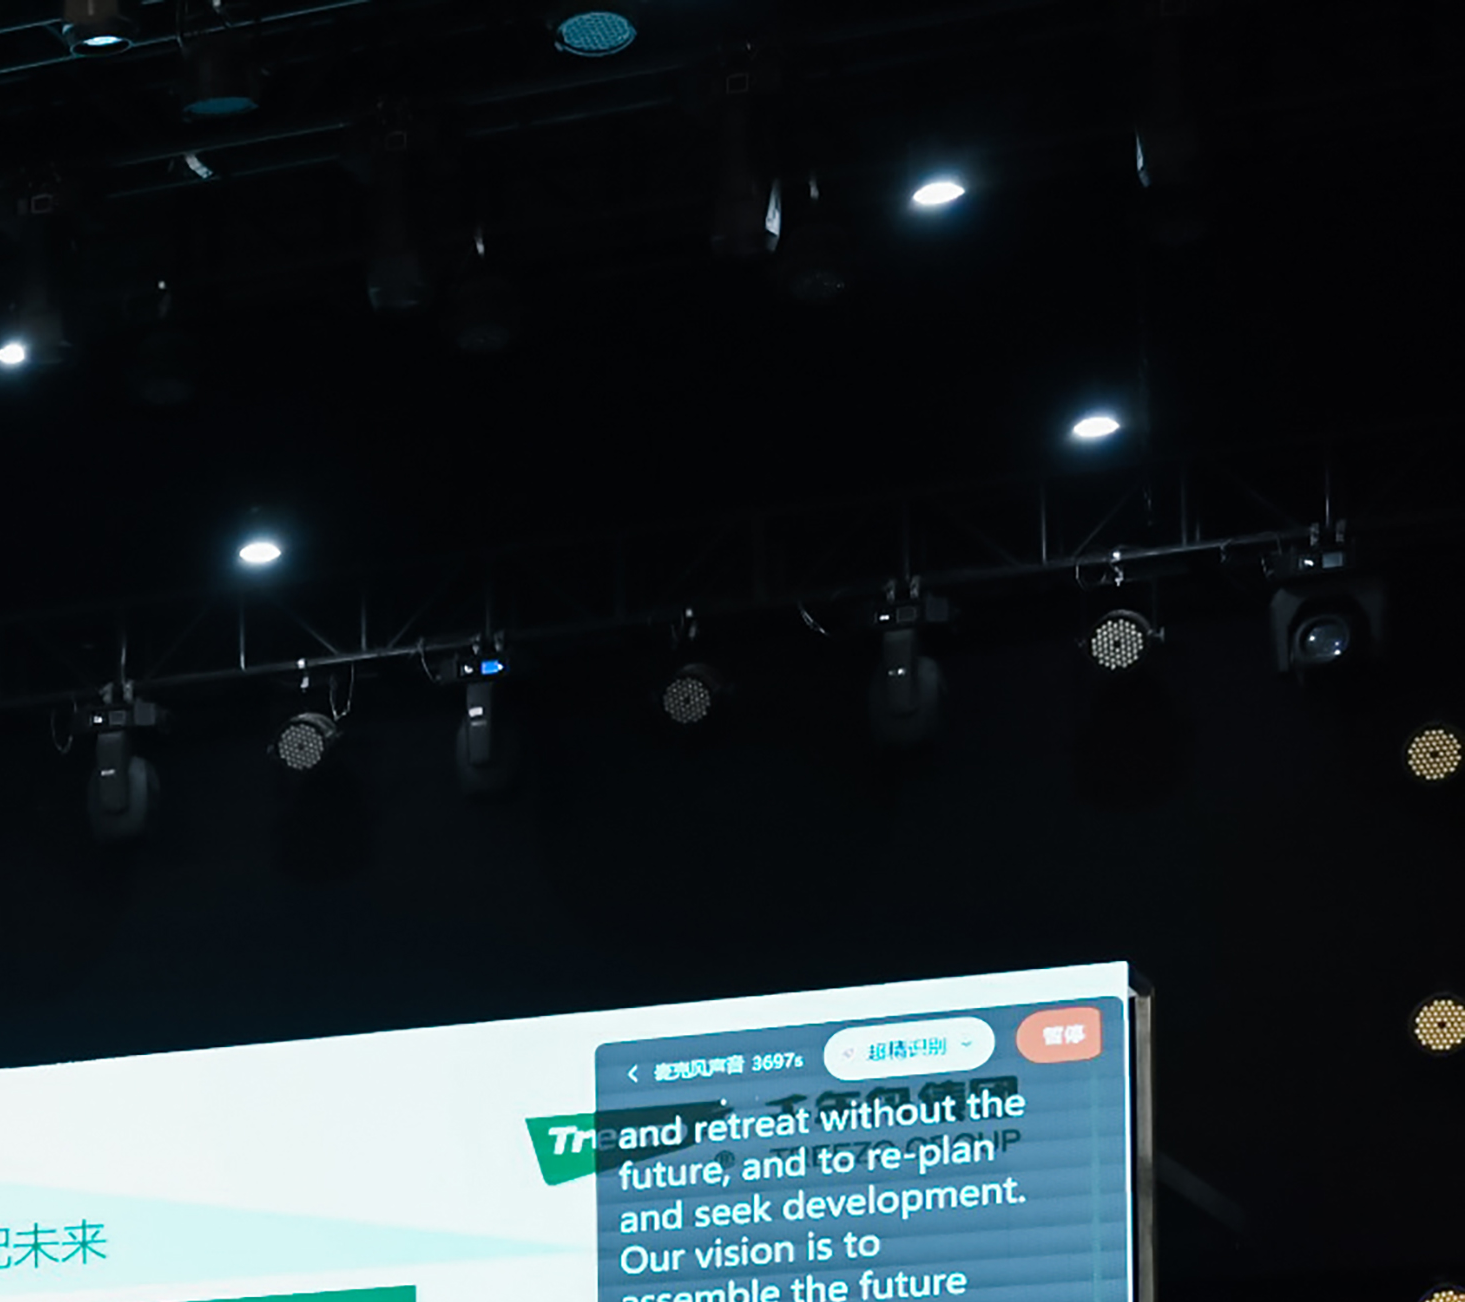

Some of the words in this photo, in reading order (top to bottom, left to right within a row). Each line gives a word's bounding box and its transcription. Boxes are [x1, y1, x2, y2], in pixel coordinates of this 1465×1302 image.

[751, 1052, 805, 1073] 3697s
[617, 1116, 683, 1150] and
[694, 1107, 809, 1143] retreat
[820, 1098, 956, 1133] without
[966, 1089, 1026, 1119] the
[618, 1160, 732, 1191] future,
[741, 1146, 806, 1179] and
[818, 1143, 855, 1174] to
[867, 1135, 995, 1181] re-plan
[619, 1201, 683, 1233] and
[694, 1195, 772, 1228] seek
[782, 1177, 1027, 1223] development.
[619, 1245, 684, 1275] Our
[695, 1236, 795, 1270] vision
[806, 1233, 833, 1262] is
[843, 1231, 880, 1259] to
[858, 1267, 967, 1301] future
